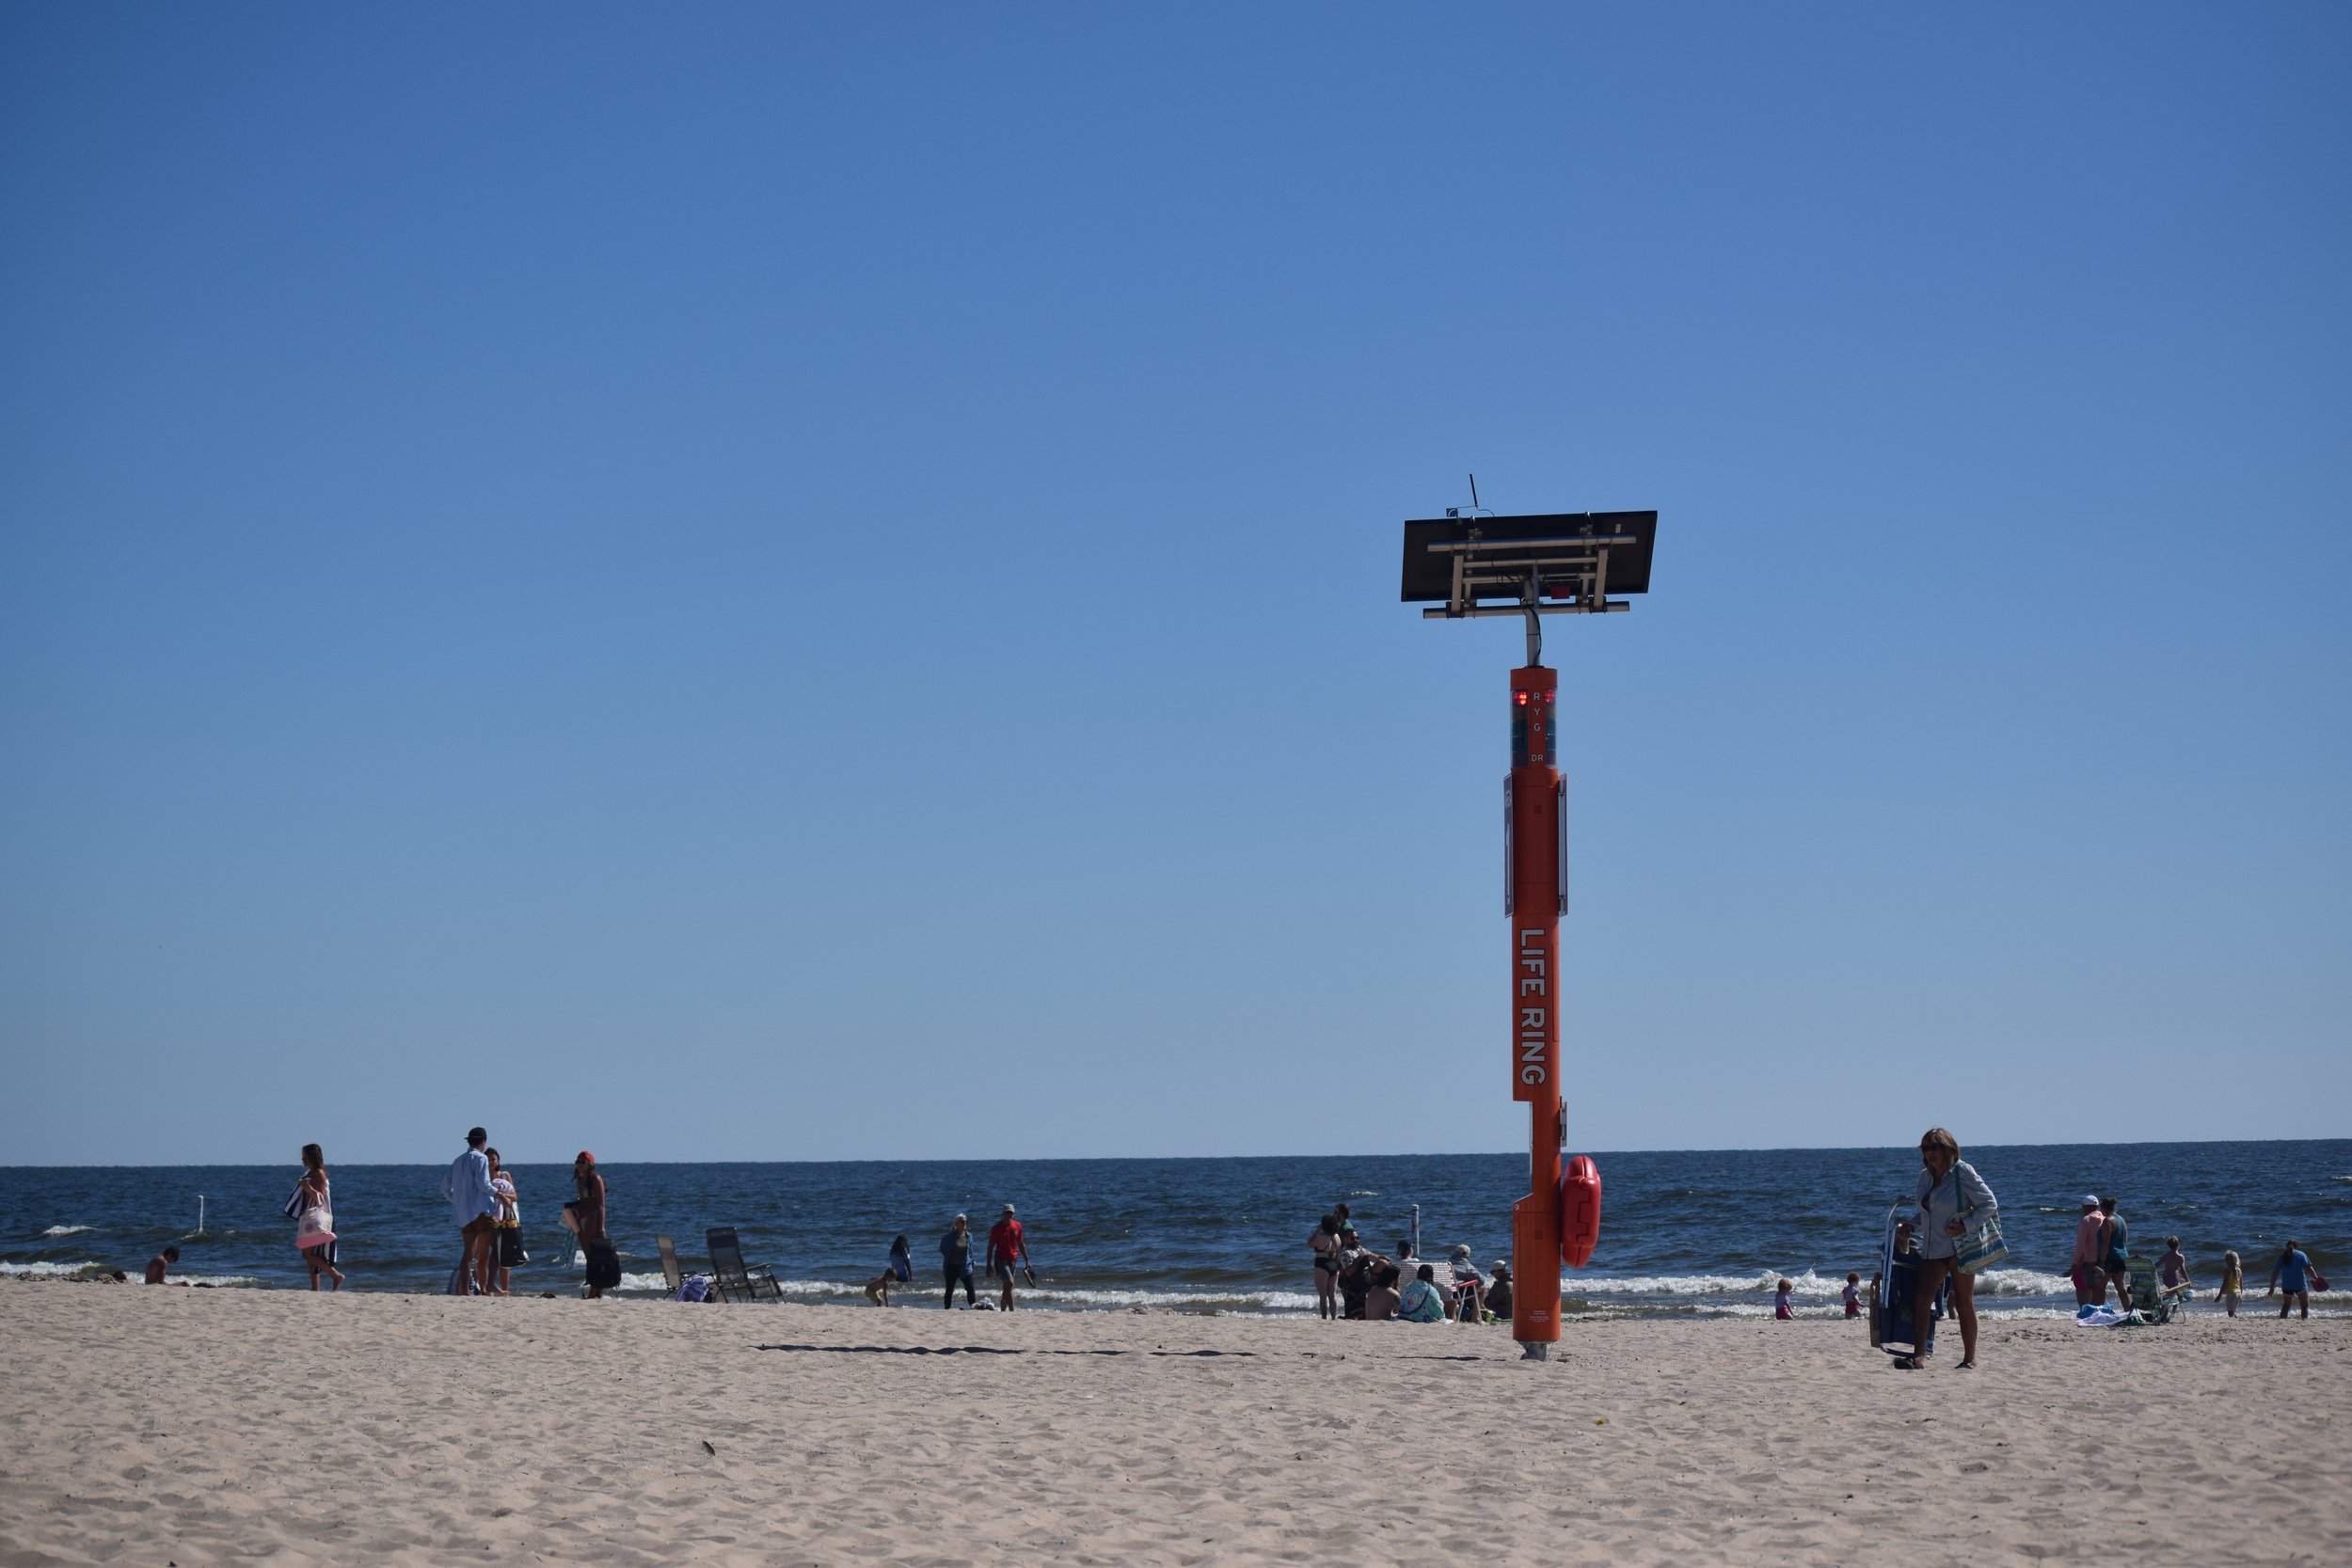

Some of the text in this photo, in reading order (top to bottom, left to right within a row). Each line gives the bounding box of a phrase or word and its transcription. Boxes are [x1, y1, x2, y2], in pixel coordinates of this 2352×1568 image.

[1534, 692, 1540, 701] R
[1534, 707, 1540, 716] Y
[1534, 722, 1540, 732] G
[1520, 928, 1547, 1085] LIFE RING
